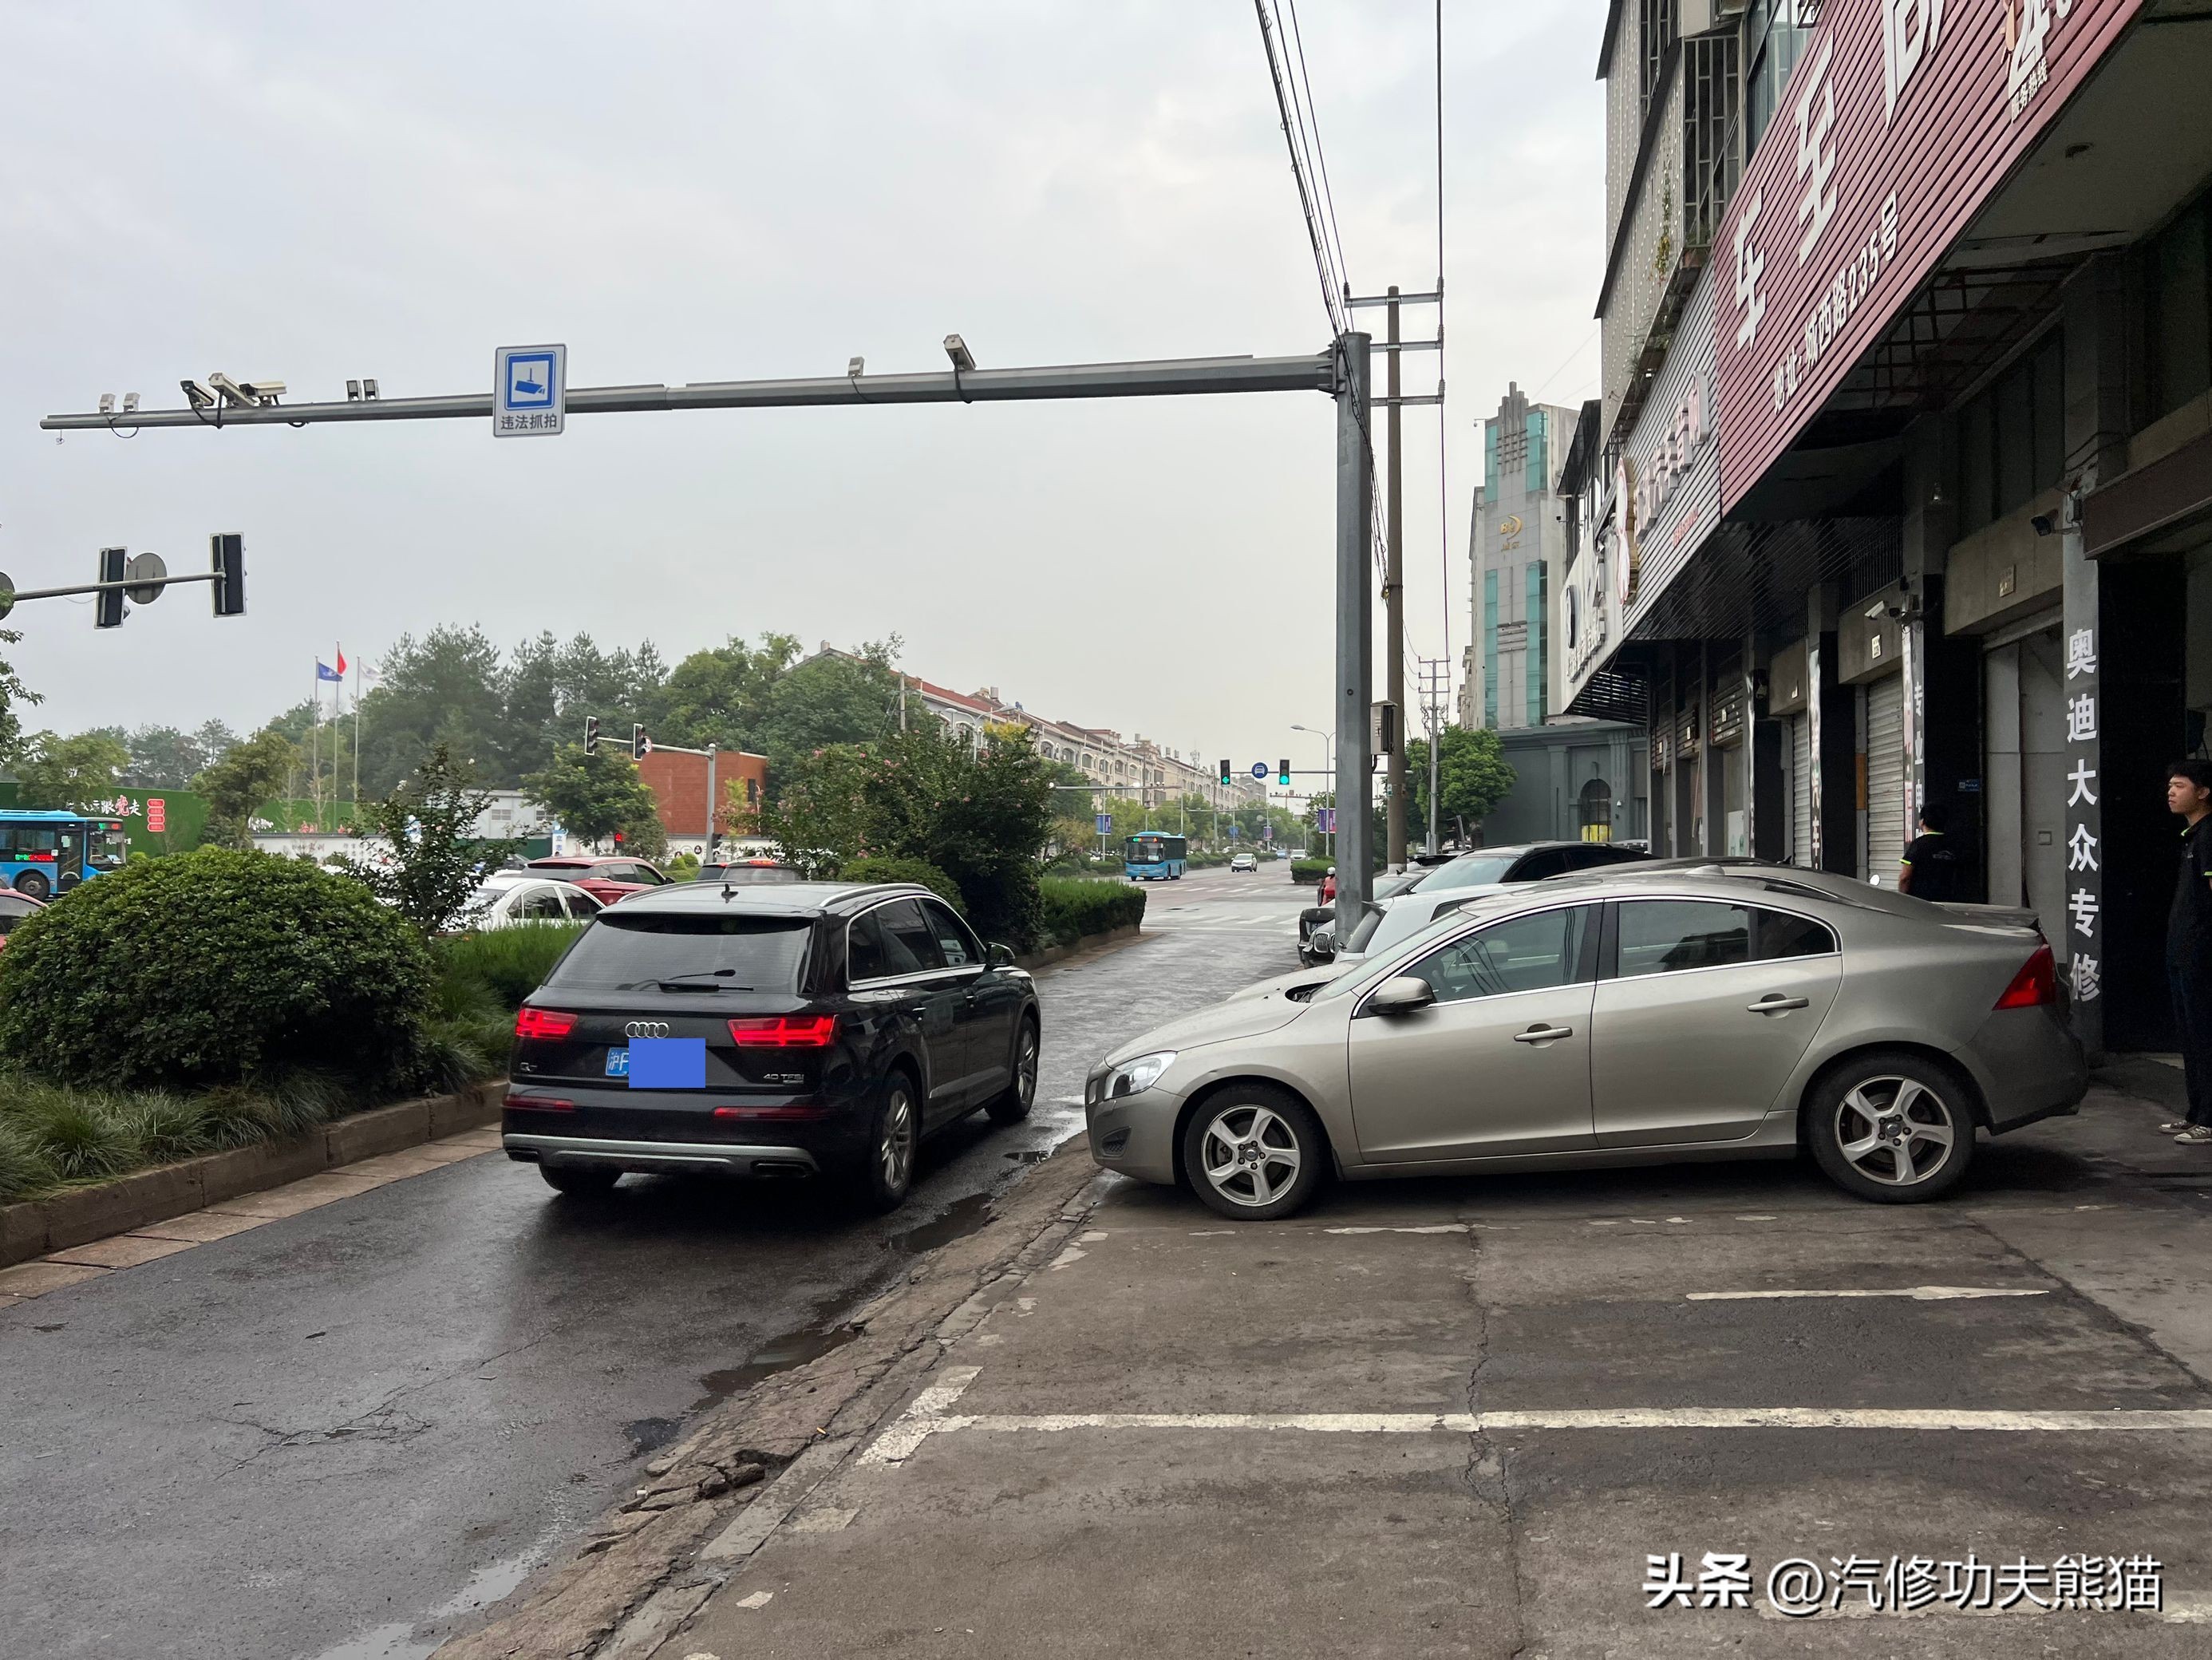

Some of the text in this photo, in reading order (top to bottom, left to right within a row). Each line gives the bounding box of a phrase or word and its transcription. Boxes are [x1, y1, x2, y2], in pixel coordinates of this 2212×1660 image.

[500, 413, 557, 430] 违法抓拍
[2066, 628, 2100, 1002] 奥迪大众专修
